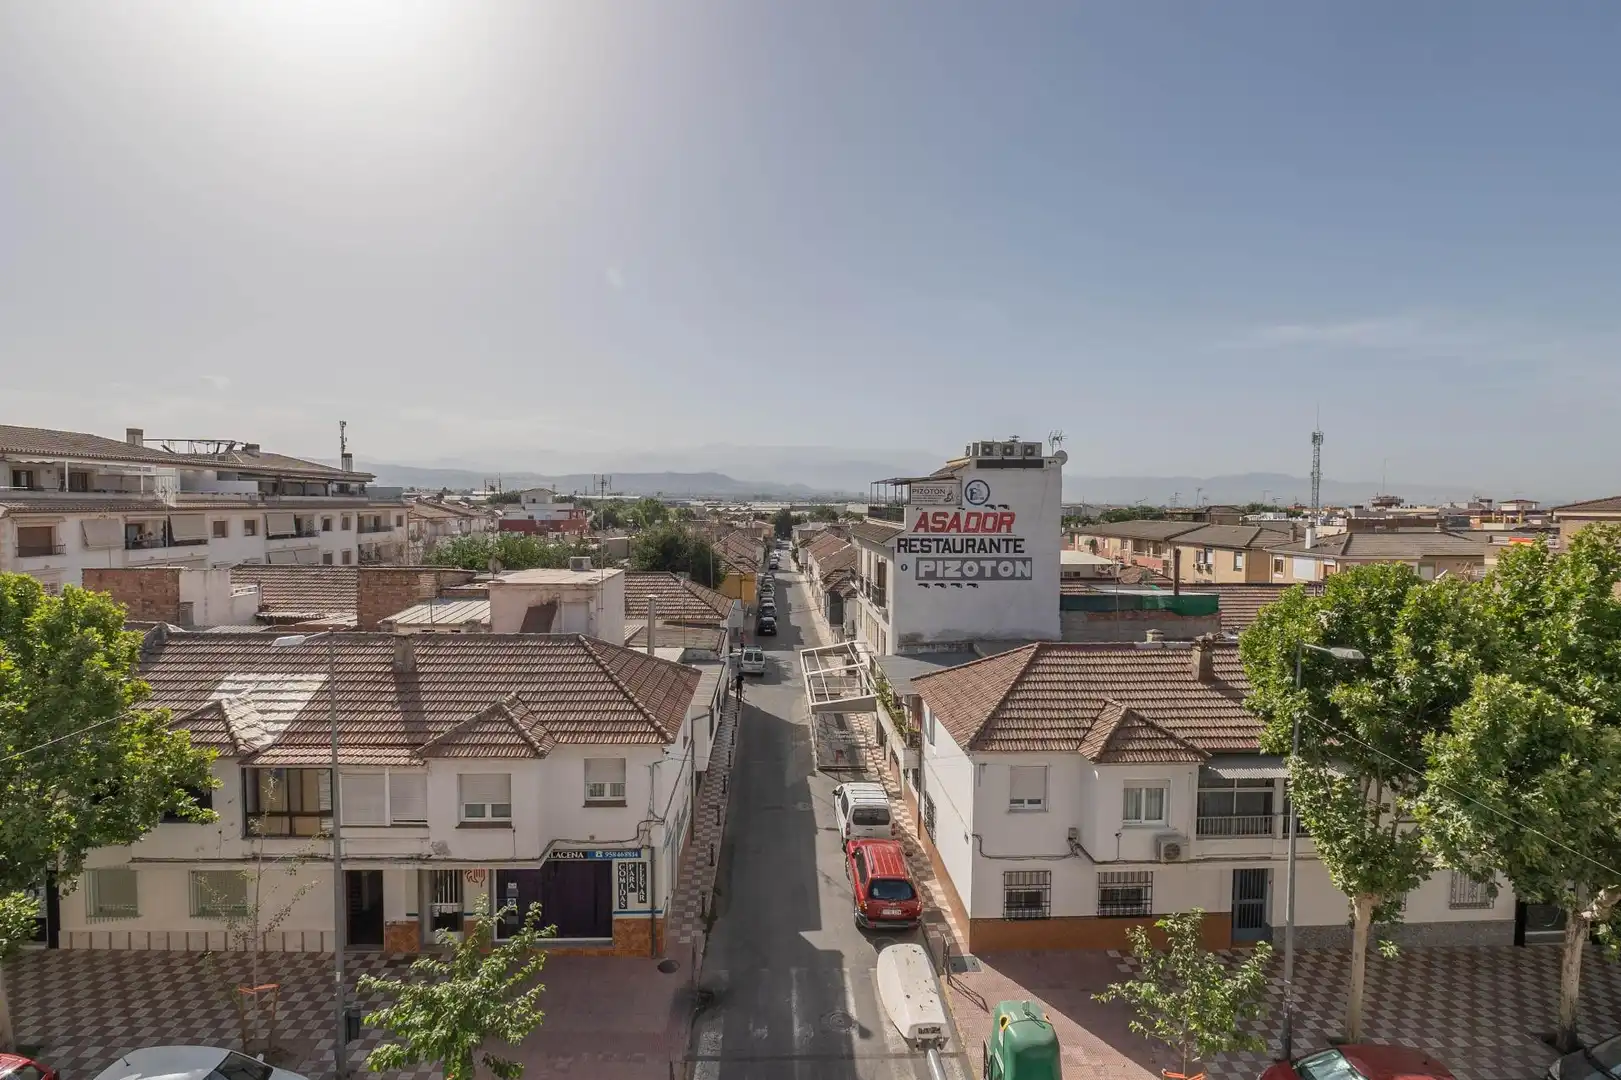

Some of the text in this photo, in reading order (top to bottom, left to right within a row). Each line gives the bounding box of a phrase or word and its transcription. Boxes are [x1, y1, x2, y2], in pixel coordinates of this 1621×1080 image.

[912, 511, 1017, 533] ASADOR
[896, 538, 1026, 554] RESTAURANTE
[918, 560, 1032, 578] PIZOTON
[618, 863, 627, 908] COMIDAS
